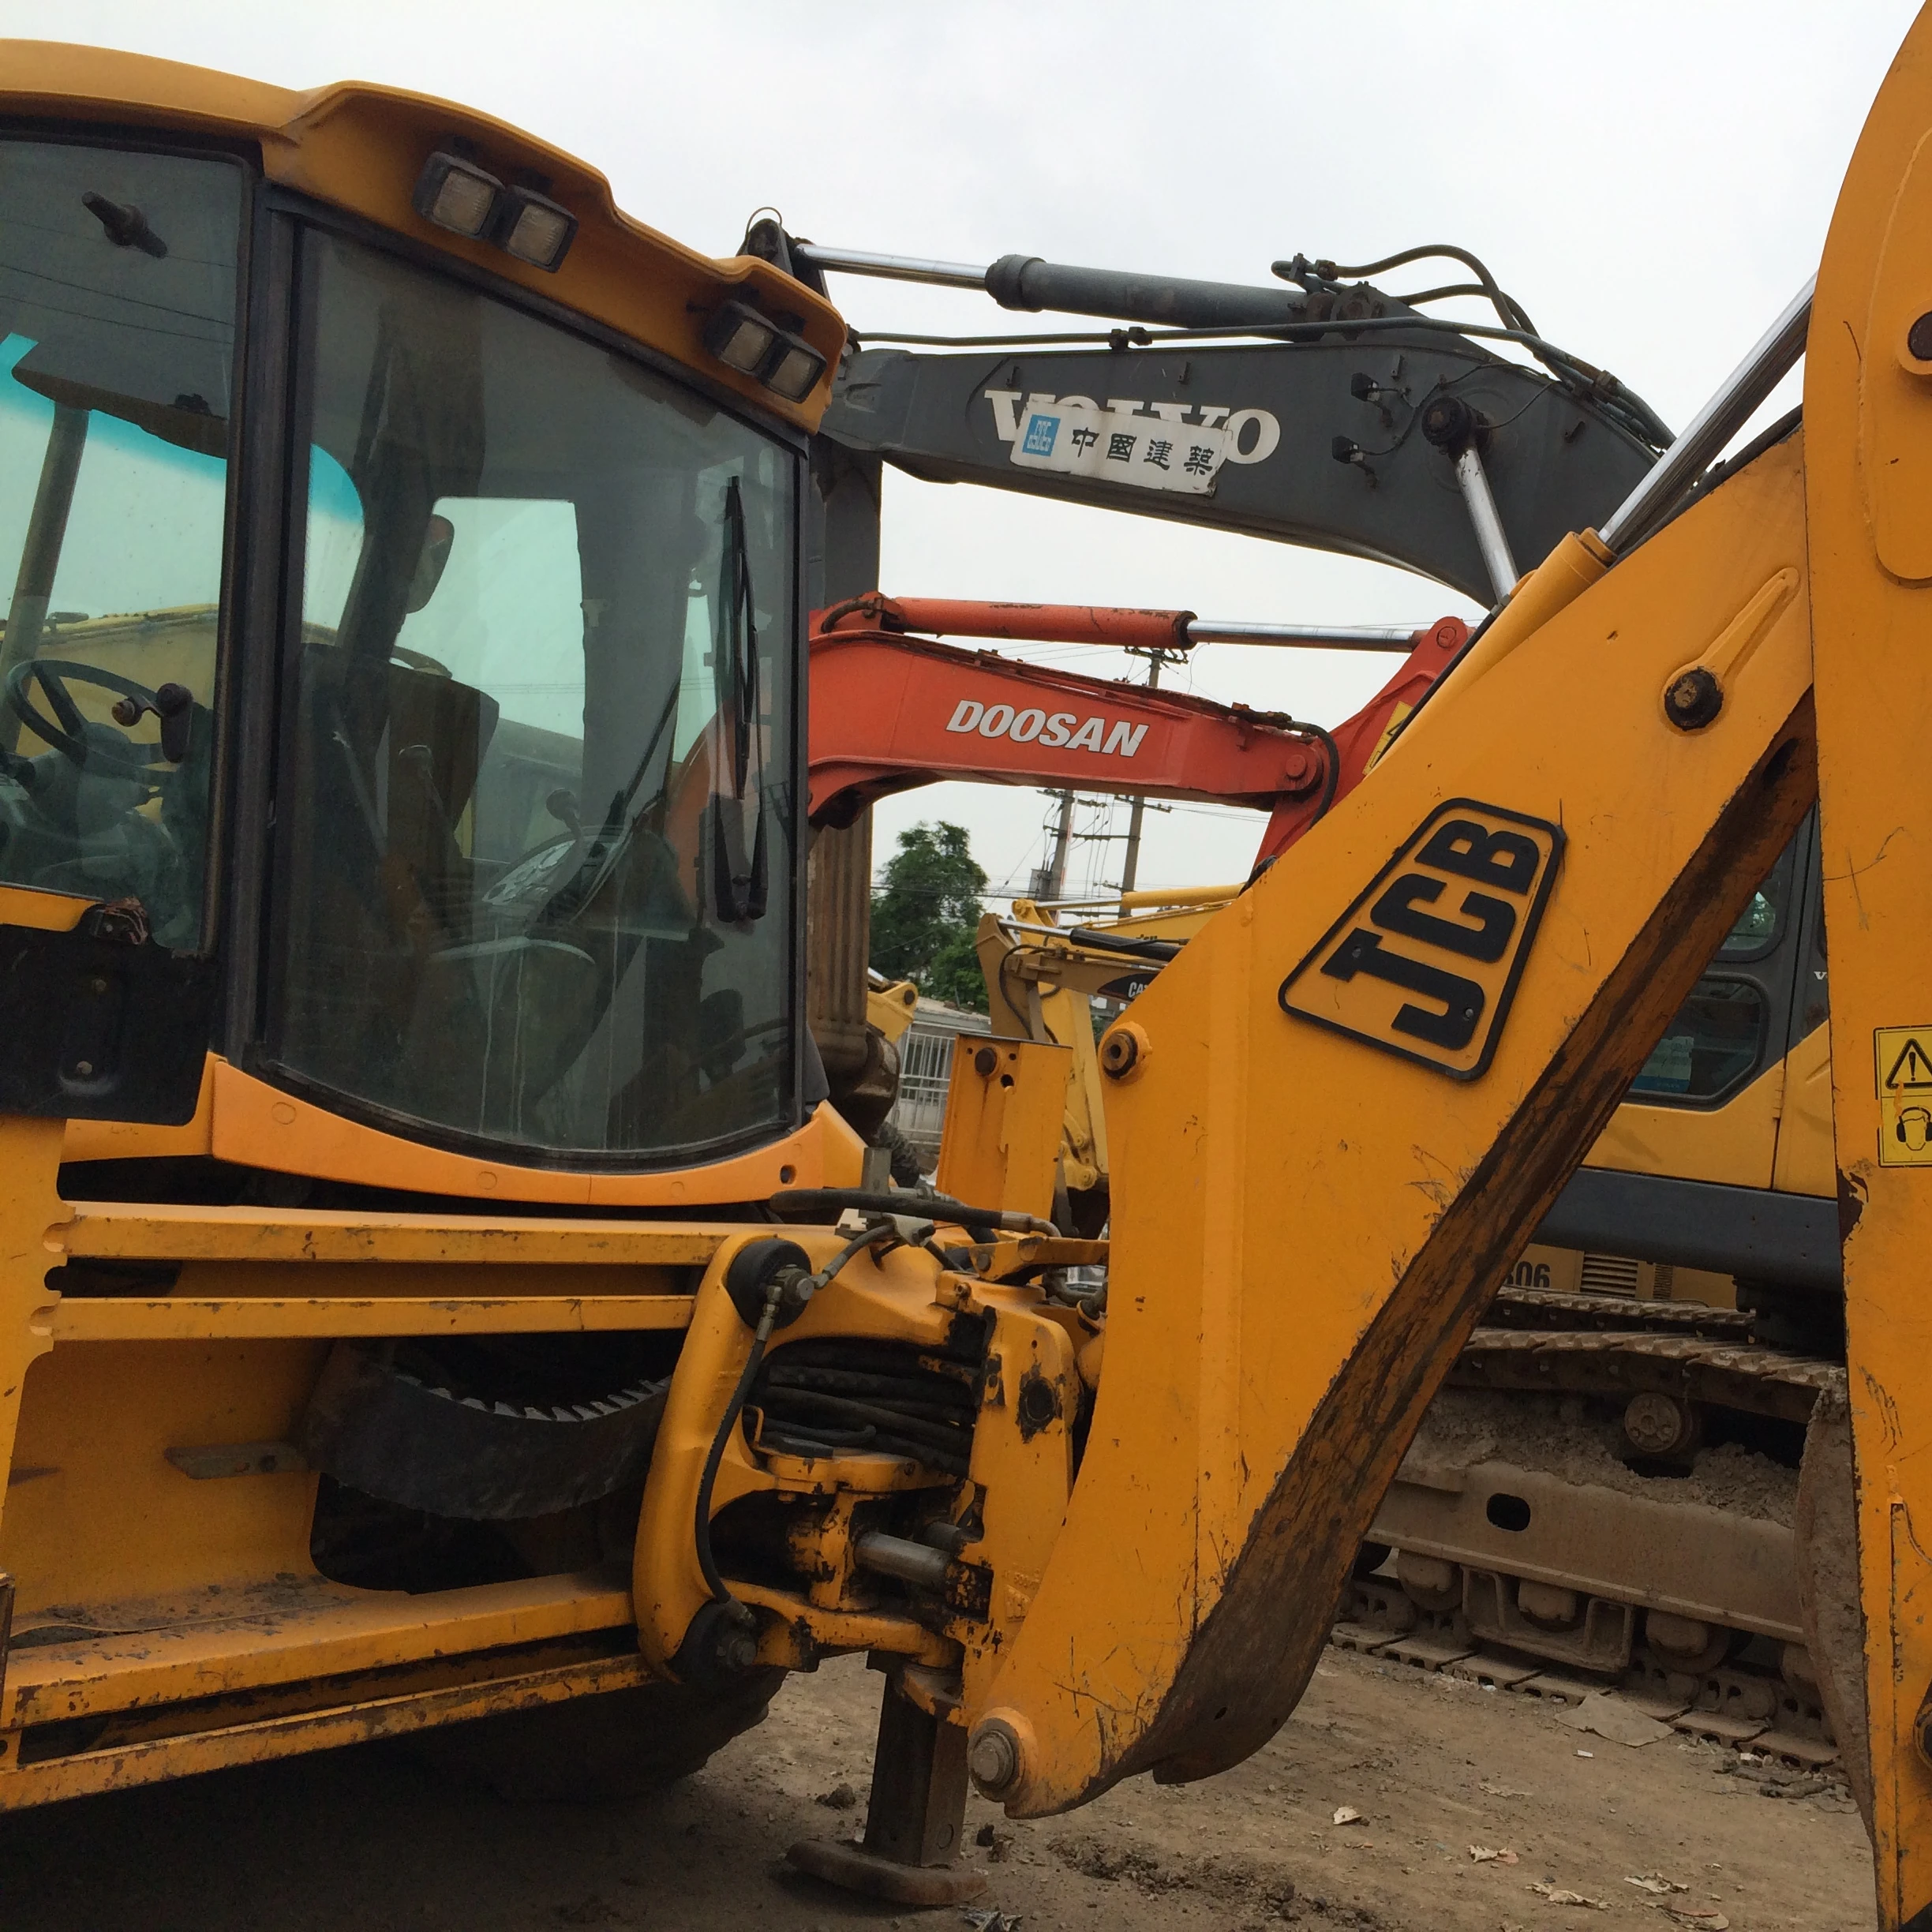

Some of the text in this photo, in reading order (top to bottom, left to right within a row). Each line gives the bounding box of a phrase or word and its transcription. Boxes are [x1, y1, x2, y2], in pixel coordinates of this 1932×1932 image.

[1072, 427, 1215, 476] 中國建築
[946, 700, 1149, 757] DOOSAN
[1320, 819, 1540, 1050] JCB
[1128, 982, 1148, 998] CA
